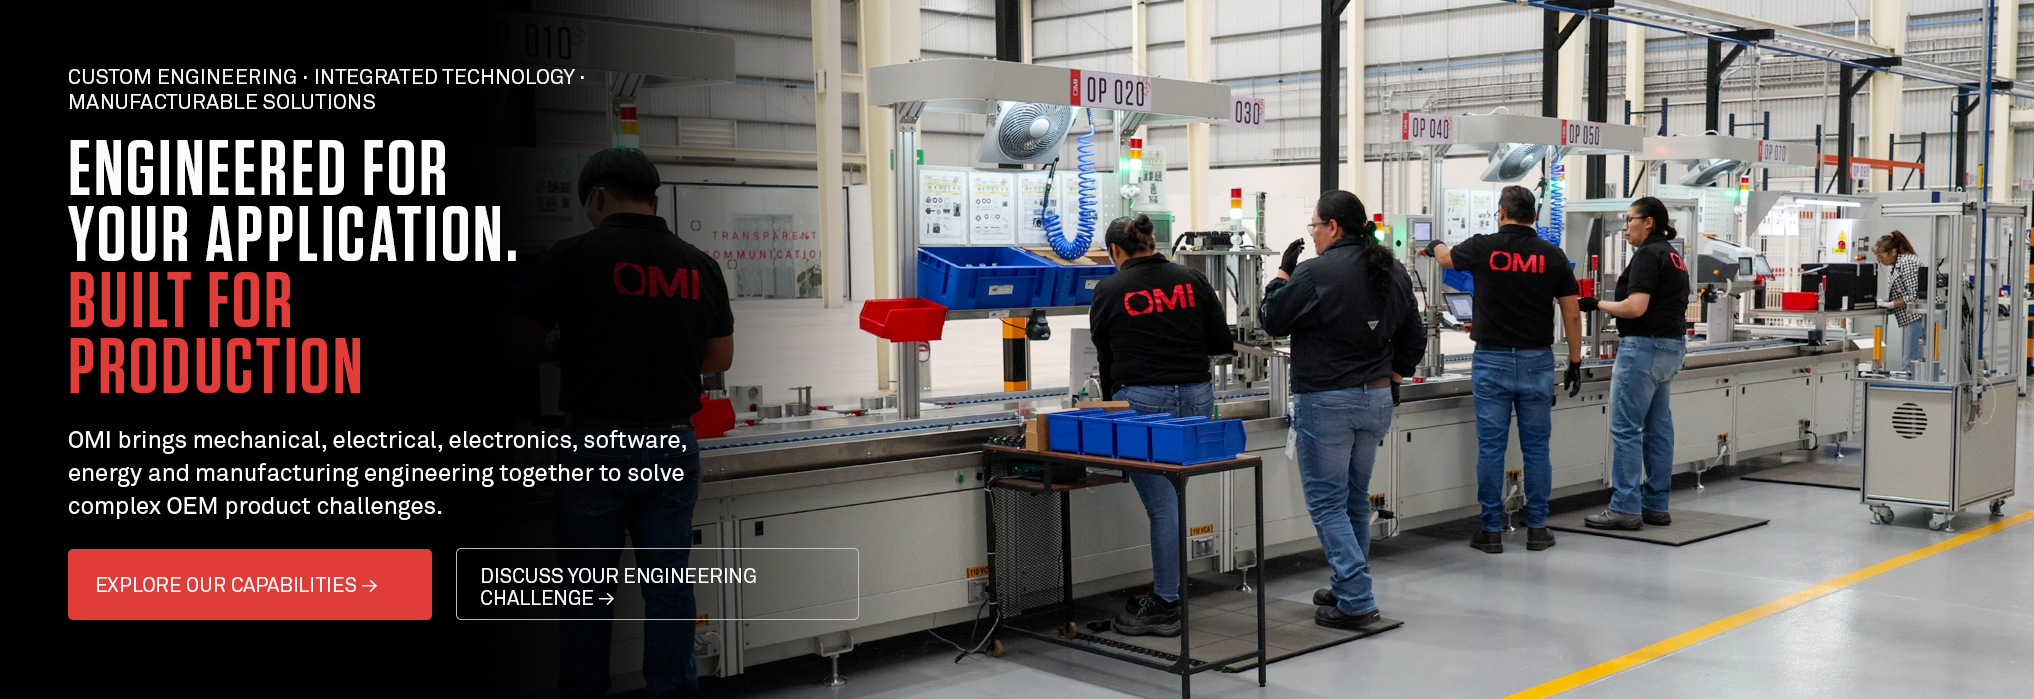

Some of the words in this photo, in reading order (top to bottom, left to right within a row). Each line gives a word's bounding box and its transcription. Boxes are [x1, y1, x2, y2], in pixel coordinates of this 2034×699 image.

[525, 22, 572, 60] 010
[1087, 76, 1107, 103] OP
[1114, 79, 1145, 107] 020
[1235, 100, 1260, 125] 030
[1412, 117, 1426, 138] OP
[1429, 118, 1449, 139] 040
[1569, 123, 1580, 144] OP
[1583, 125, 1600, 145] 050
[1764, 144, 1773, 160] OP
[1774, 145, 1786, 161] 070
[712, 231, 817, 241] TRANSPARENT
[1489, 250, 1545, 274] OMI
[612, 261, 700, 300] OMI
[1123, 283, 1195, 317] OMI
